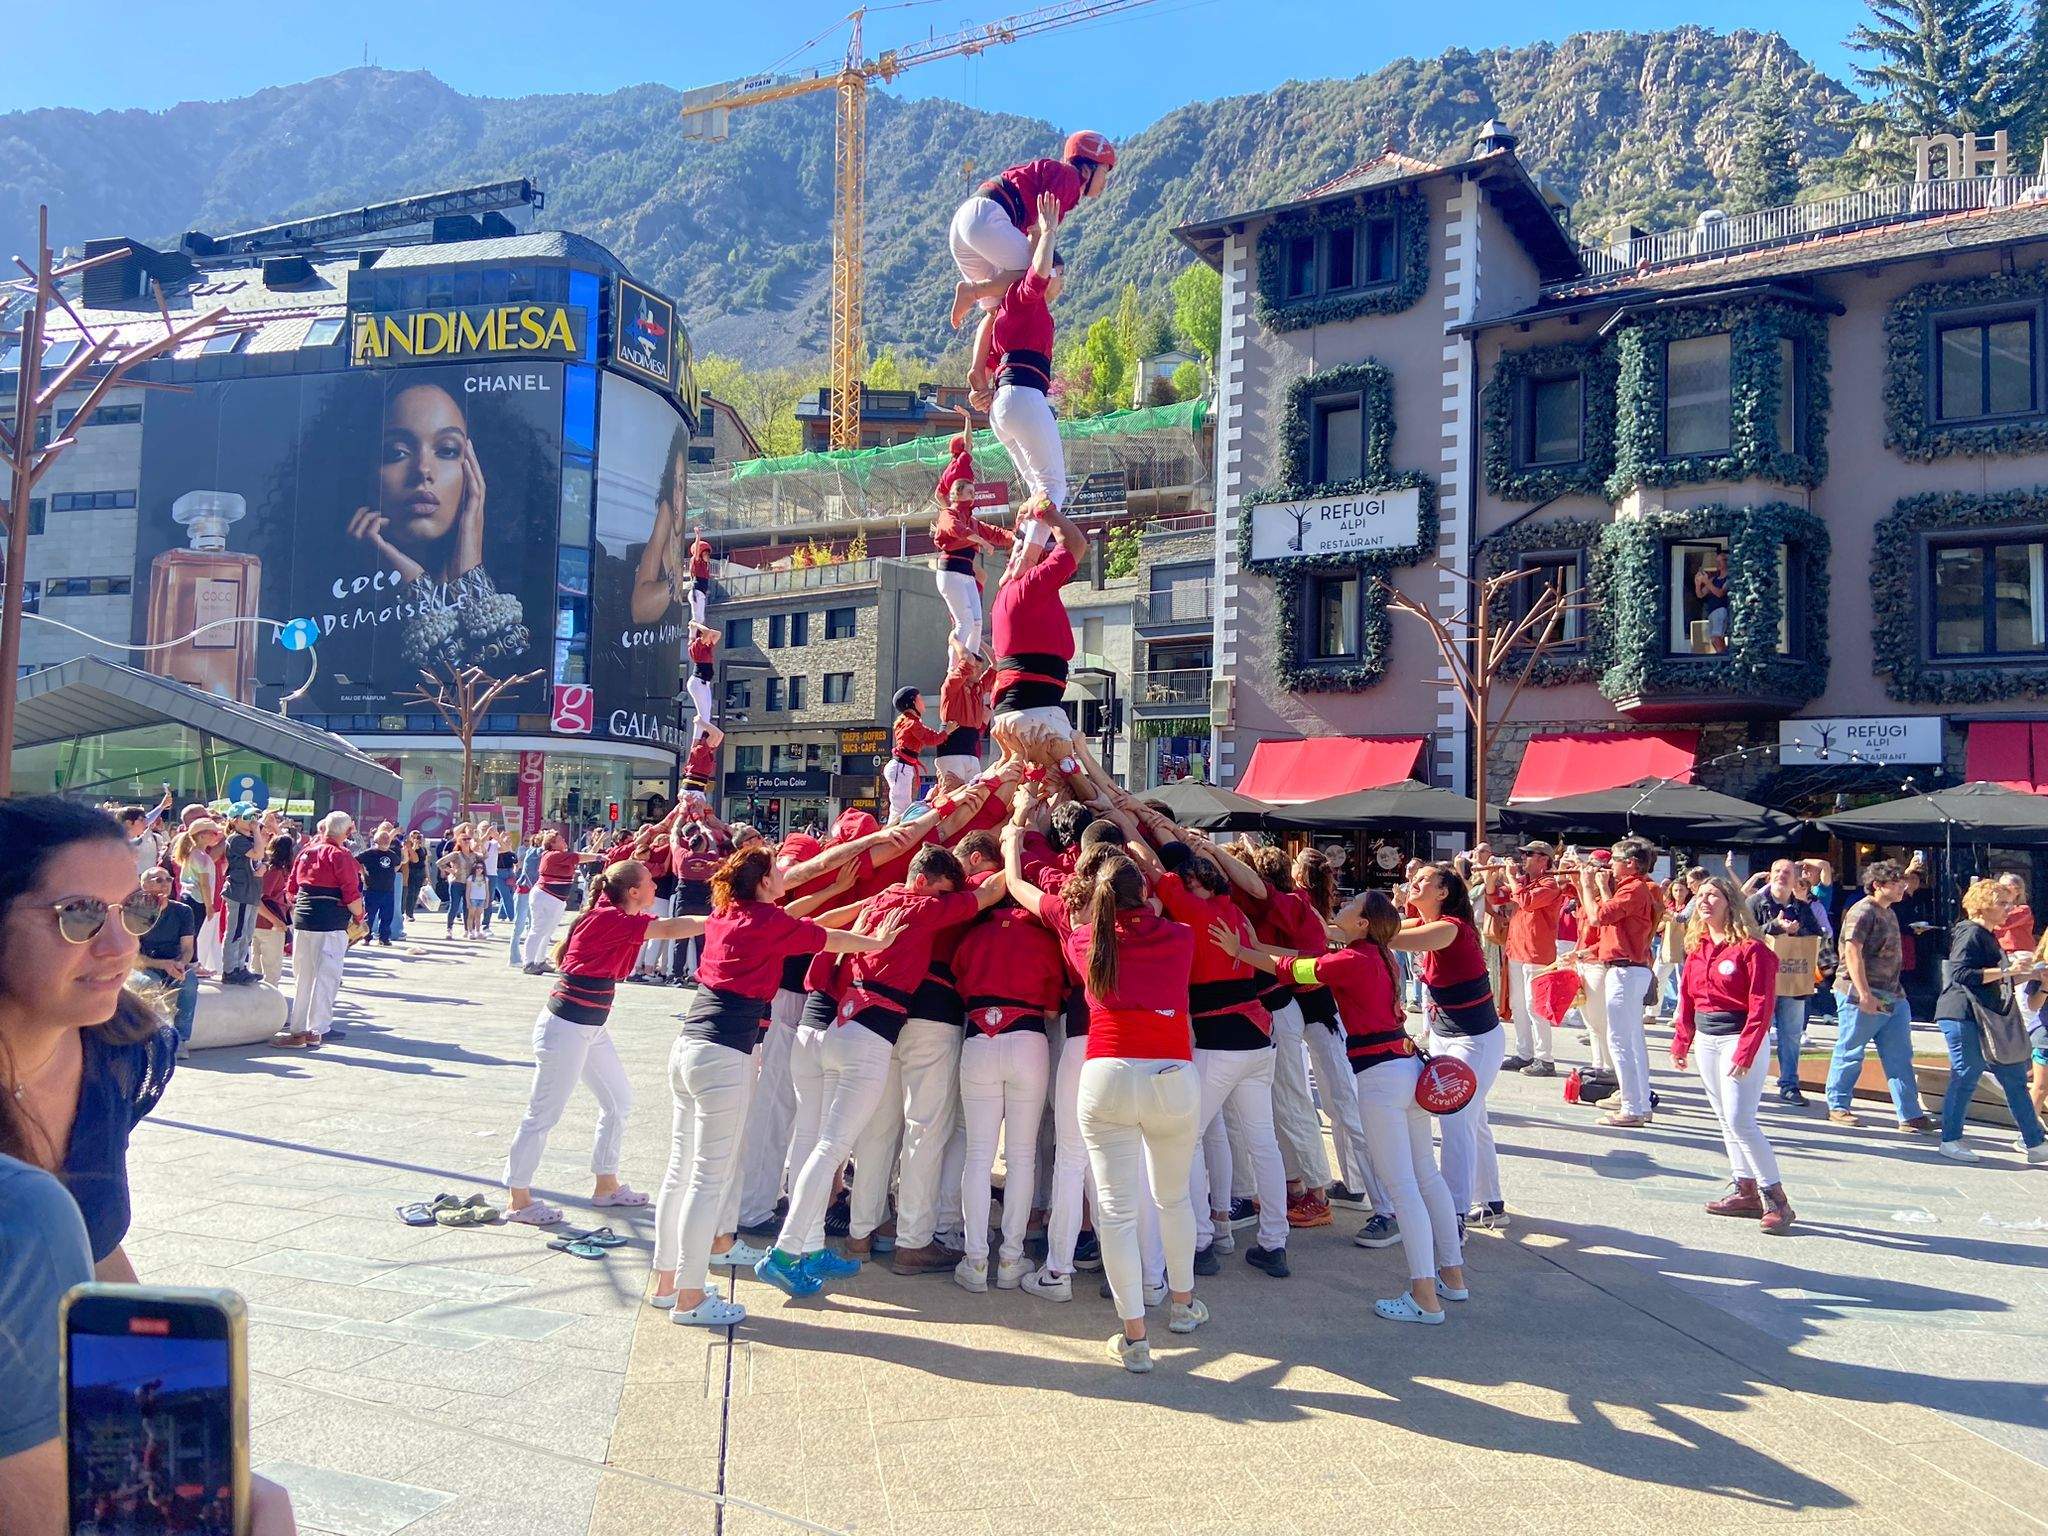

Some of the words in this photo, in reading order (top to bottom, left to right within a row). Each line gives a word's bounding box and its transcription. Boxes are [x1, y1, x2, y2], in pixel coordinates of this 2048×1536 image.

[354, 306, 577, 359] ANDIMESA
[620, 345, 668, 378] ANDIMESA
[464, 375, 551, 393] CHANEL
[1320, 500, 1385, 521] REFUGI
[1340, 518, 1366, 530] ALPI
[1320, 536, 1384, 550] RESTAURANT
[332, 570, 402, 599] COCO
[609, 709, 660, 741] GALA
[1847, 725, 1907, 738] REFUGI
[1866, 738, 1890, 747] ALPI
[758, 777, 773, 787] Foto
[789, 777, 807, 787] Color
